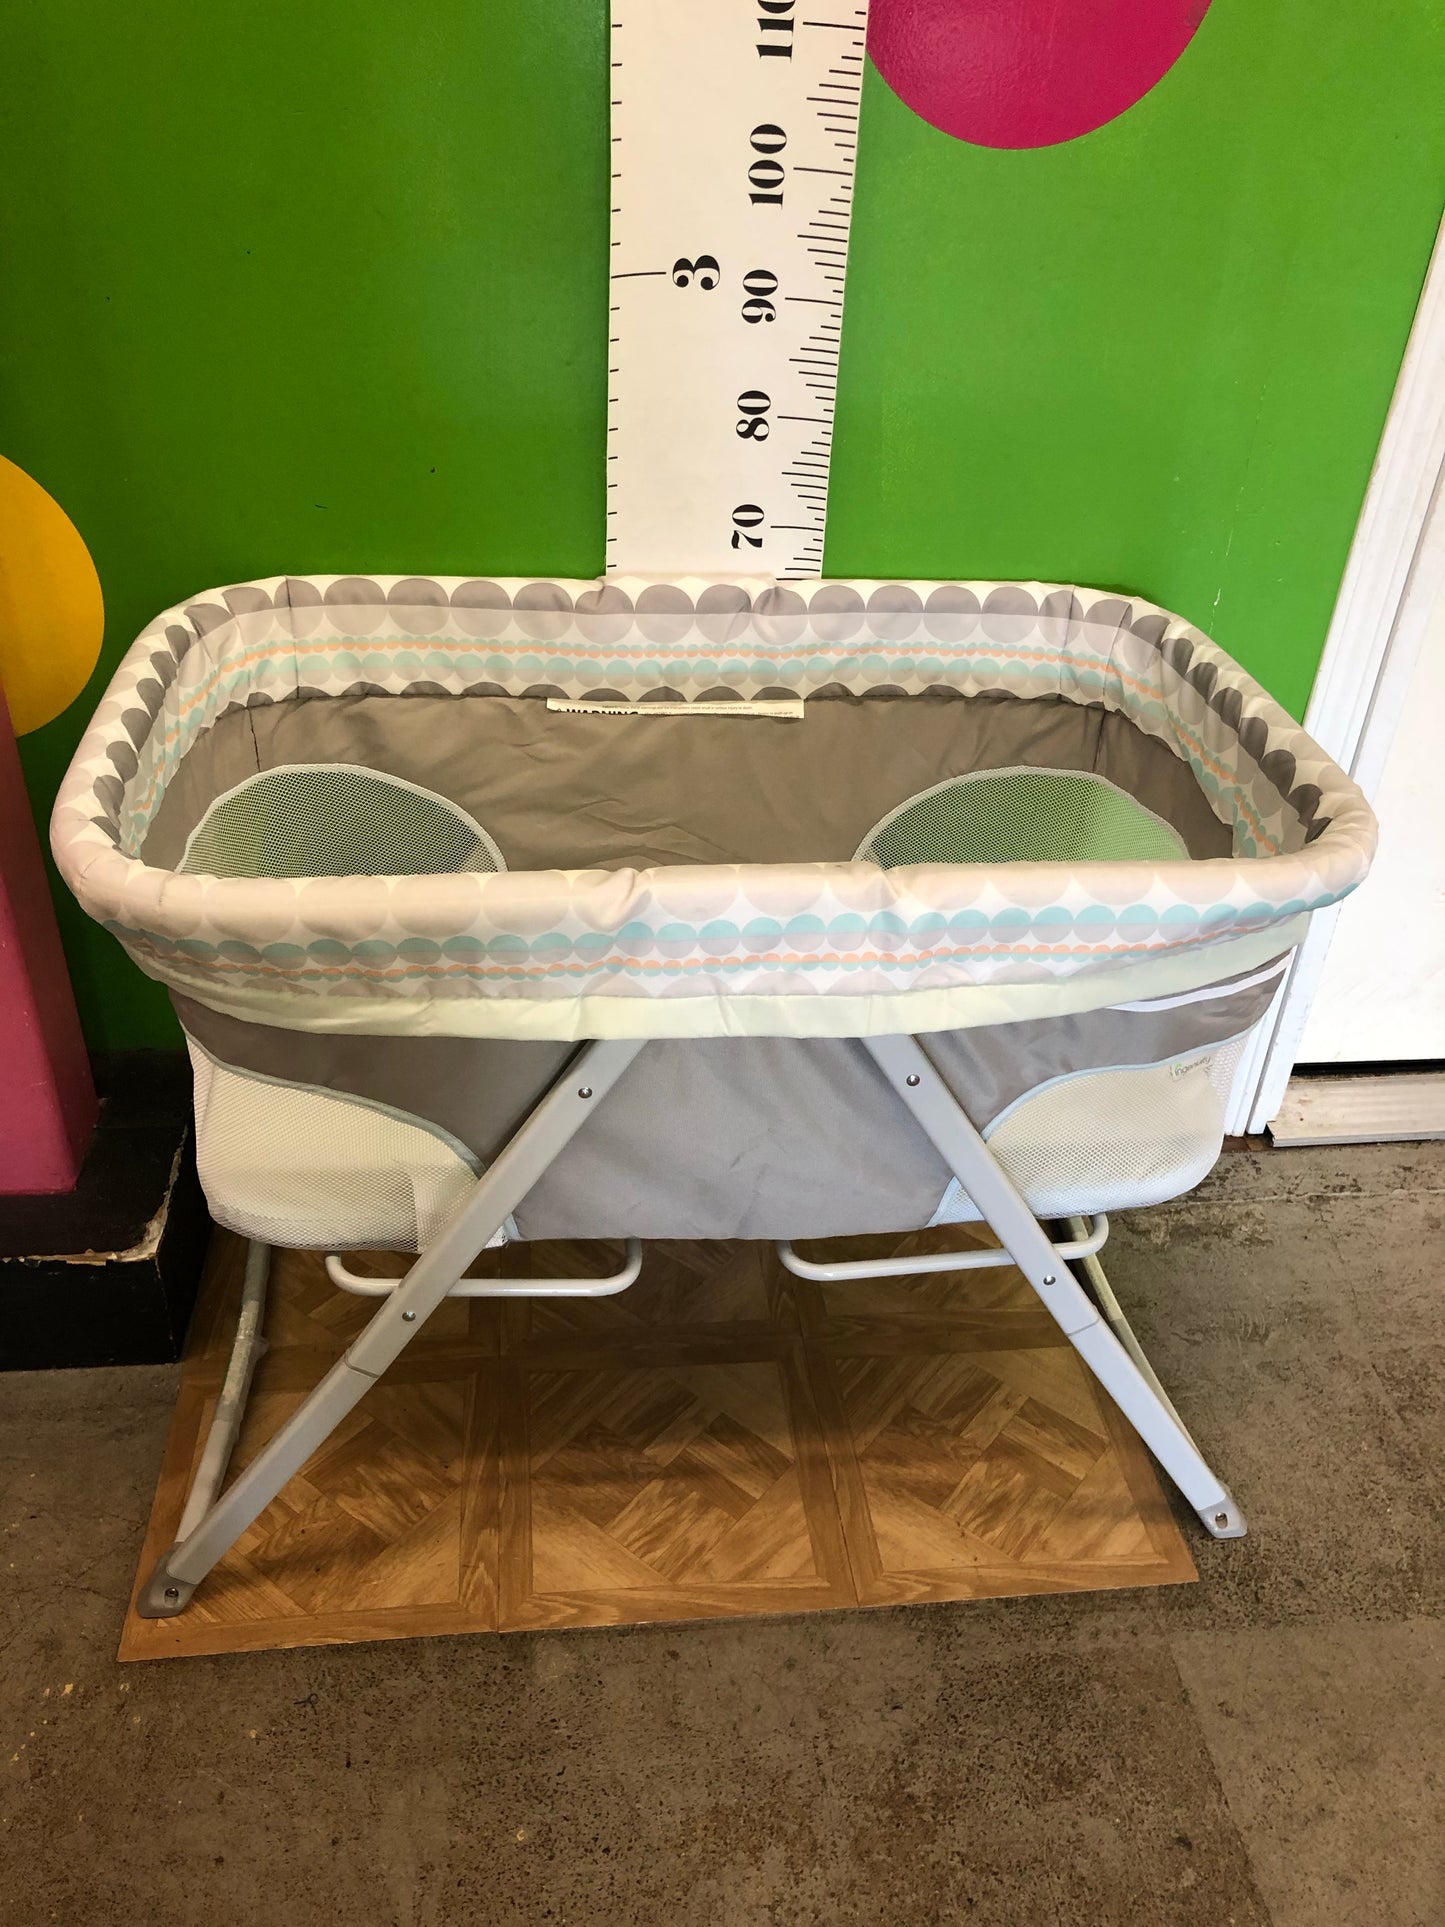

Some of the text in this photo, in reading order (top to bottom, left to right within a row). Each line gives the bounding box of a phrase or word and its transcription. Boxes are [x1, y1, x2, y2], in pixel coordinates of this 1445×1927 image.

[748, 124, 786, 206] 100
[673, 255, 720, 290] 3
[742, 270, 778, 323] 90
[736, 391, 771, 441] 80
[732, 504, 764, 549] 70
